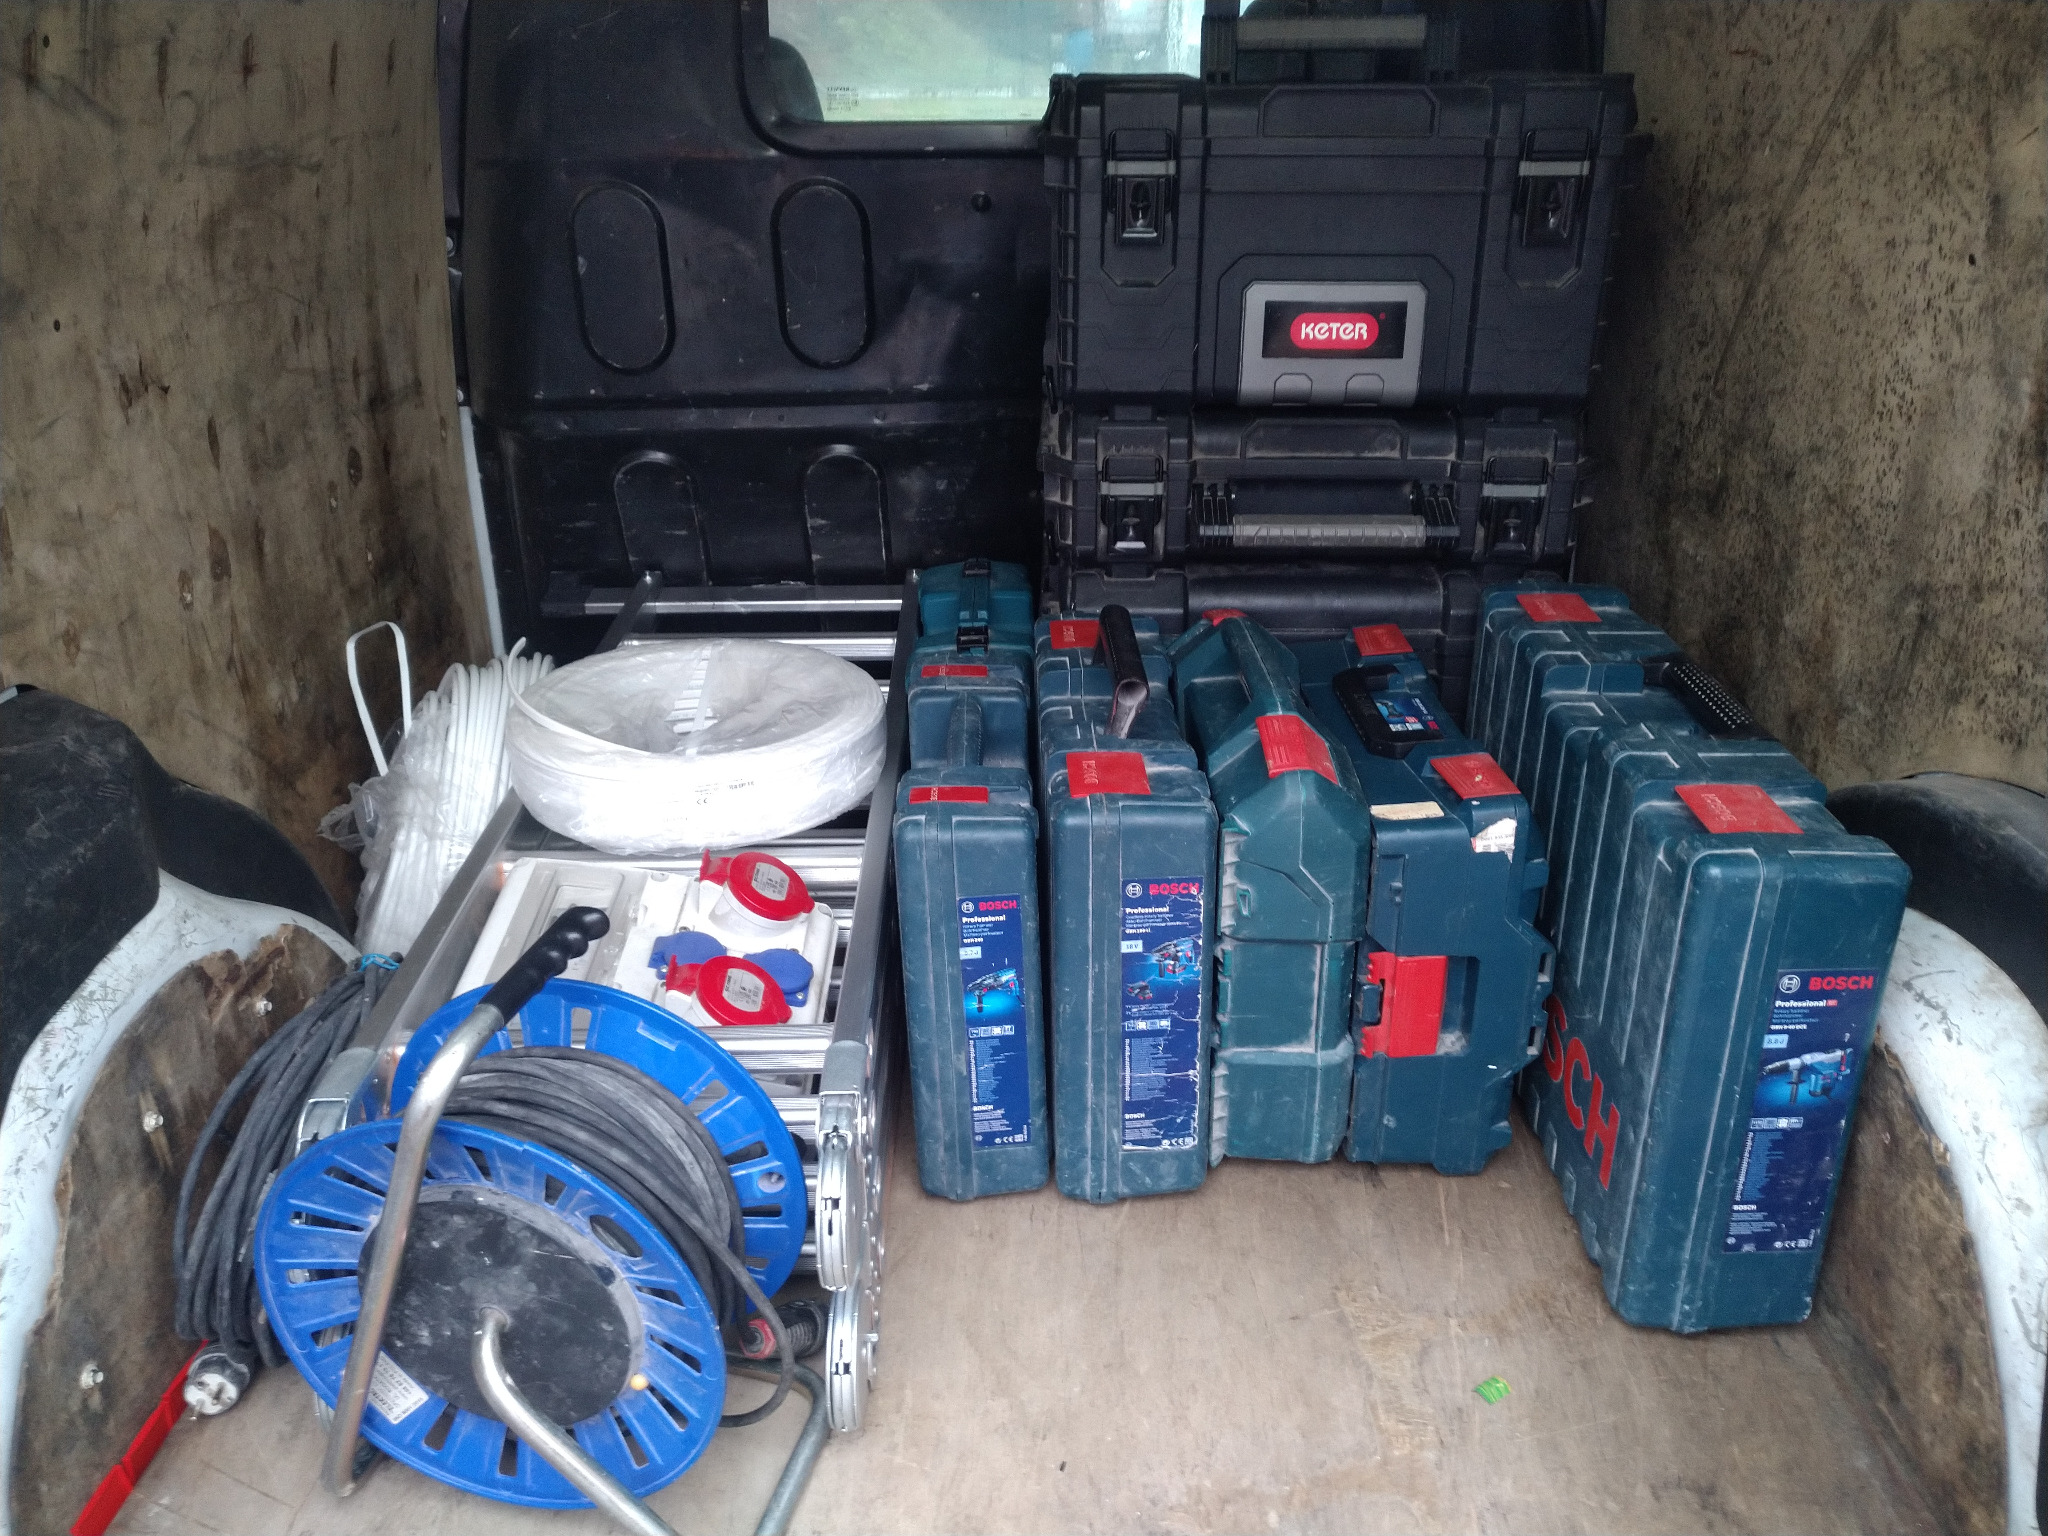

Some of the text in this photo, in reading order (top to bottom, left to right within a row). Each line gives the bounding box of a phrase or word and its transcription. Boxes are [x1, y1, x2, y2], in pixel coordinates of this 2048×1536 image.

[1149, 882, 1200, 896] BOSCH
[979, 900, 1017, 911] BOSCH
[962, 914, 1005, 923] Professional
[1808, 975, 1874, 991] BOSCH
[1774, 1000, 1826, 1008] Professional
[1542, 993, 1620, 1190] SCH
